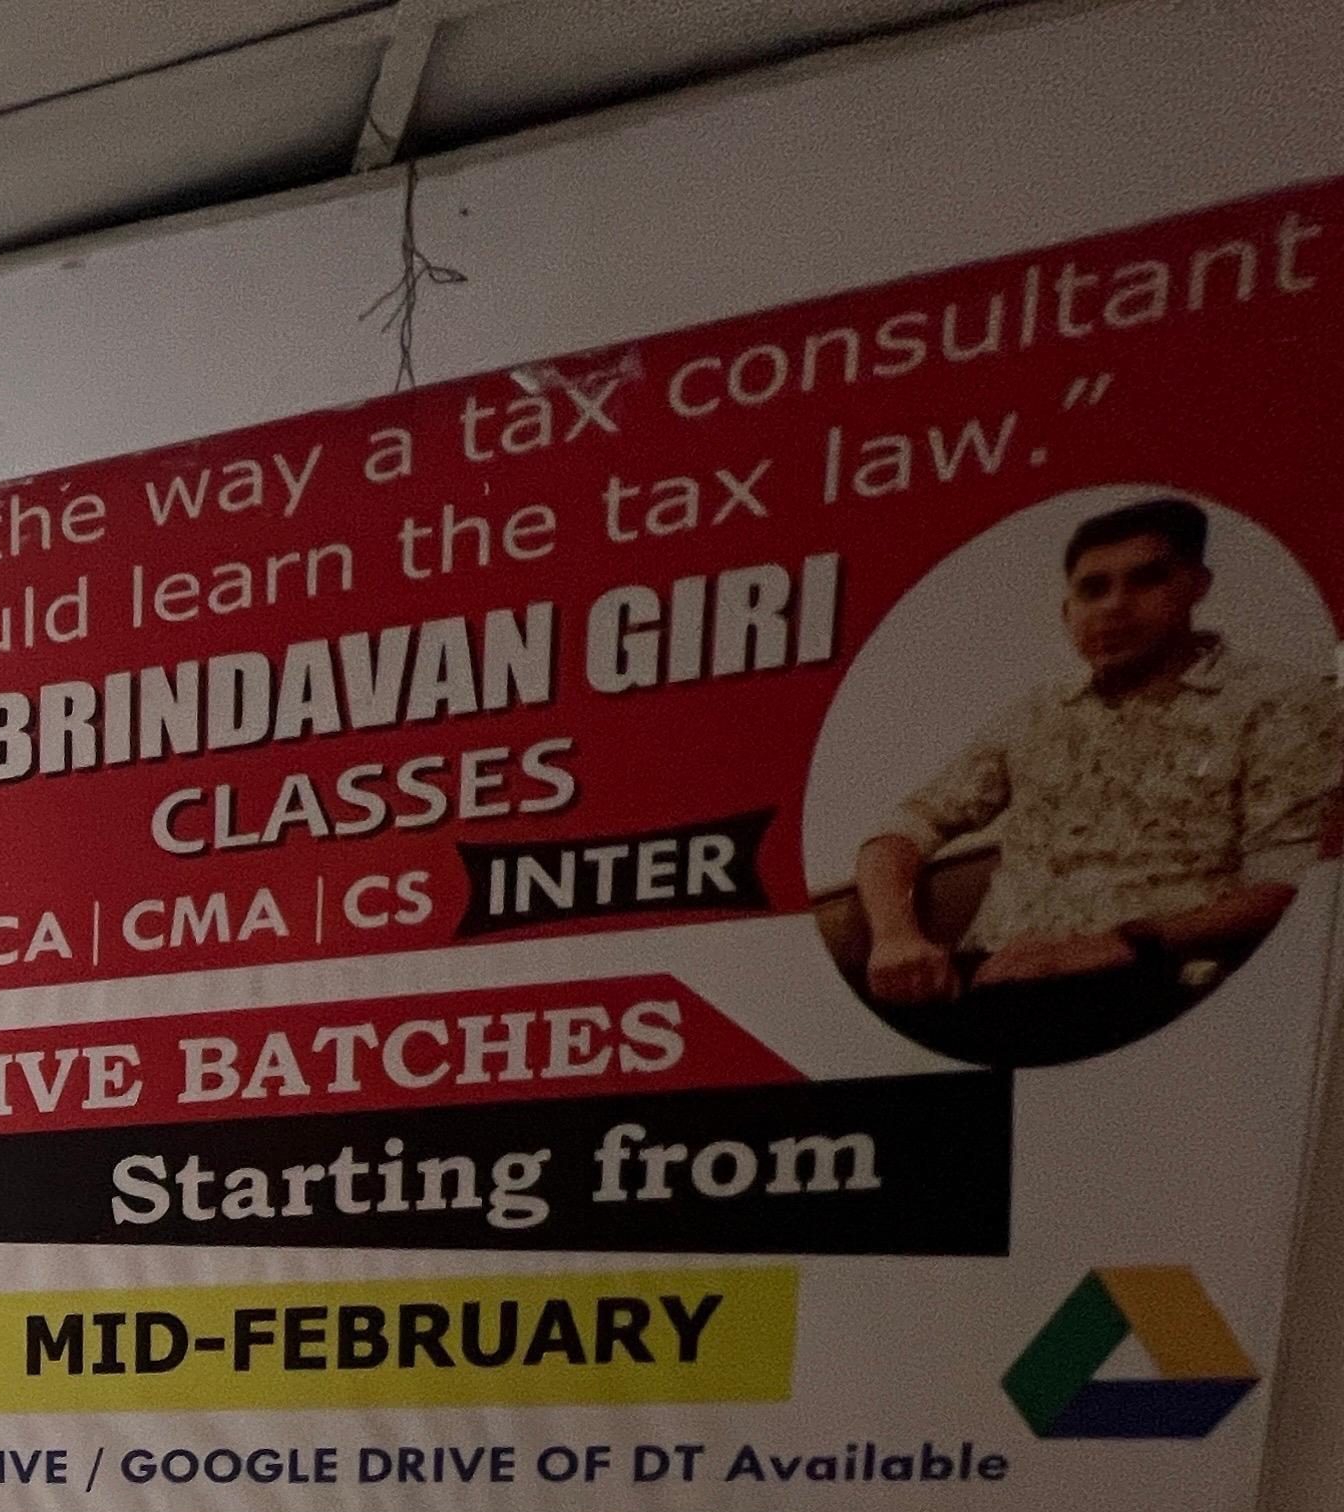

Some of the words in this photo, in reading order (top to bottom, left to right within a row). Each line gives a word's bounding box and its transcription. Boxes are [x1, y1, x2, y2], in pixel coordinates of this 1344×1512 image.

[146, 445, 323, 525] way
[365, 426, 415, 484] a
[460, 382, 620, 462] tax
[668, 210, 1323, 419] consultant
[132, 542, 353, 627] learn
[400, 503, 556, 580] the
[603, 457, 773, 543] tax
[584, 552, 843, 694] GIRI
[150, 737, 580, 855] CLASSES
[120, 886, 290, 952] CMA
[342, 869, 435, 930] CS
[487, 832, 740, 918] INTER
[177, 1000, 686, 1105] BATCHES
[112, 1136, 552, 1230] Starting
[592, 1122, 882, 1202] from
[25, 1294, 725, 1377] MID-FEBRUARY
[121, 1446, 338, 1485] GOOGLE
[359, 1445, 516, 1484] DRIVE
[536, 1444, 614, 1483] OF
[634, 1444, 707, 1484] DT
[724, 1441, 1011, 1484] Available
